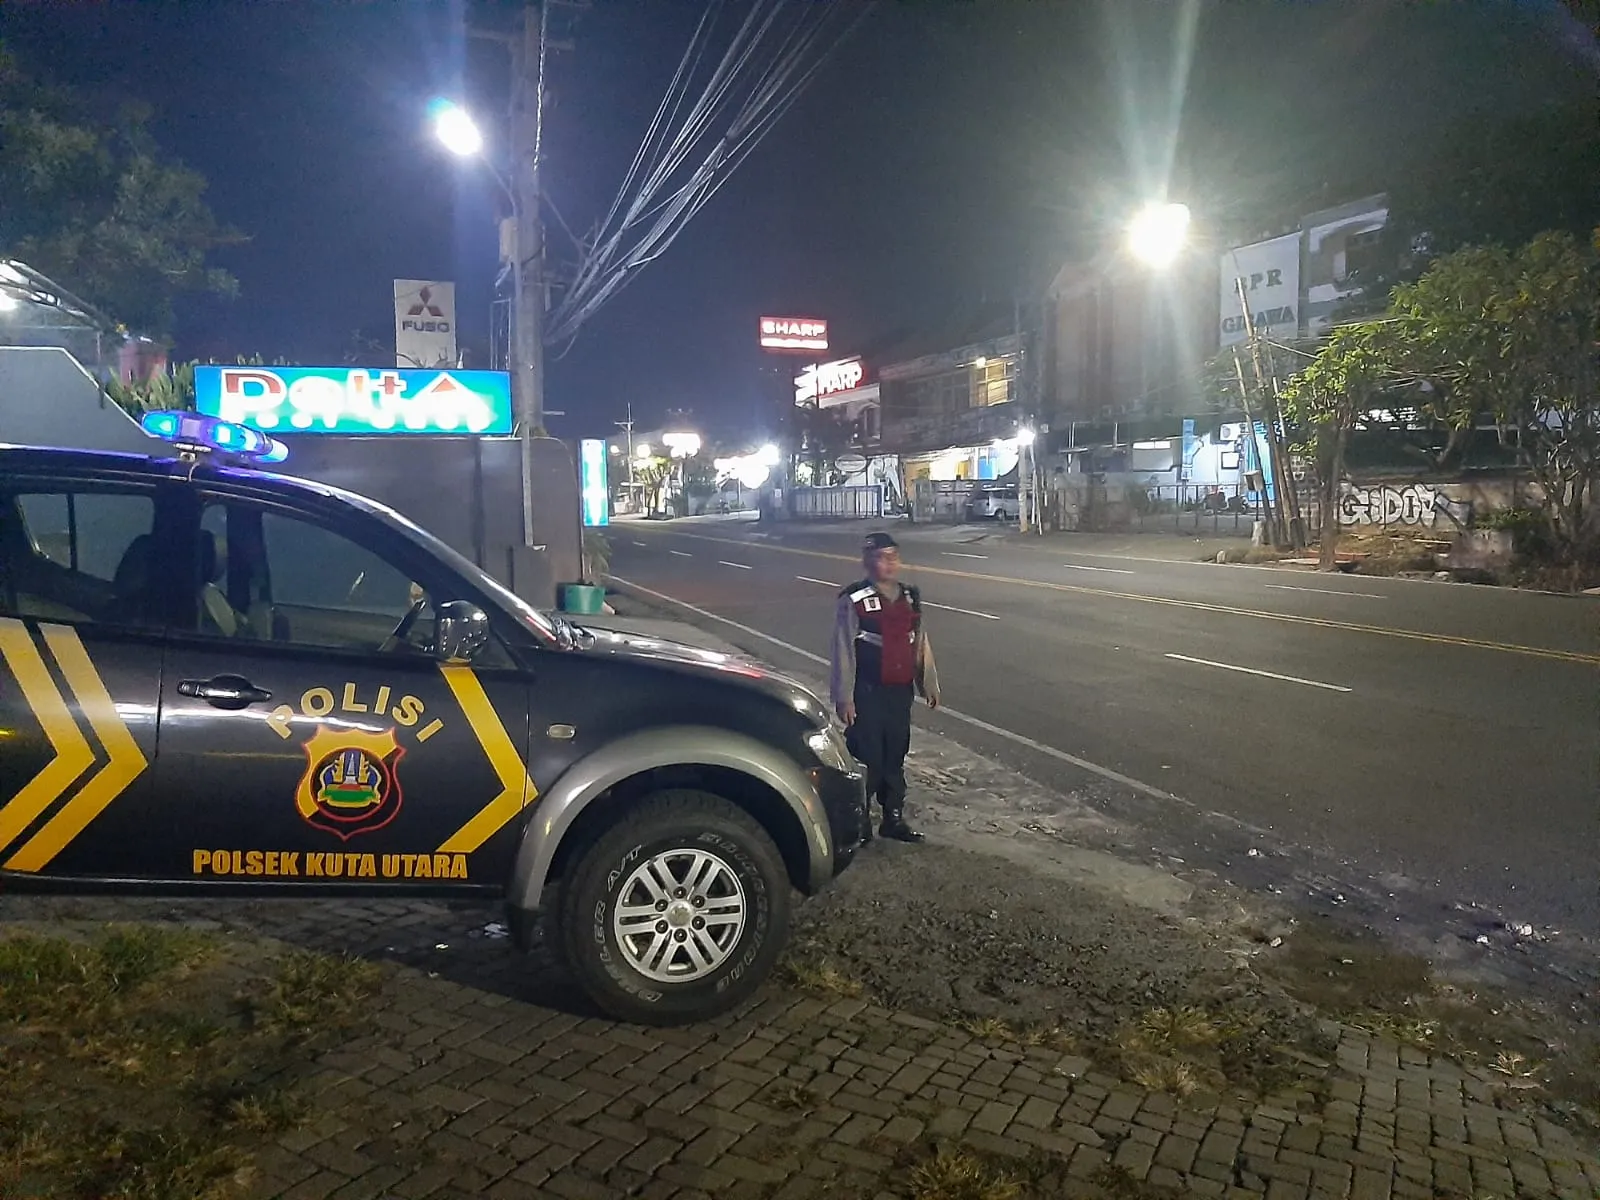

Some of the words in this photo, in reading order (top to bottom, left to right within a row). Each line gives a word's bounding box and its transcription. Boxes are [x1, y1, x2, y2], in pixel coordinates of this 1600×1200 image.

[401, 319, 450, 333] FUSO
[761, 320, 826, 337] SHARP
[264, 681, 445, 743] POLISI
[192, 848, 300, 876] POLSEK
[305, 851, 377, 878] KUTA
[381, 853, 469, 880] UTARA
